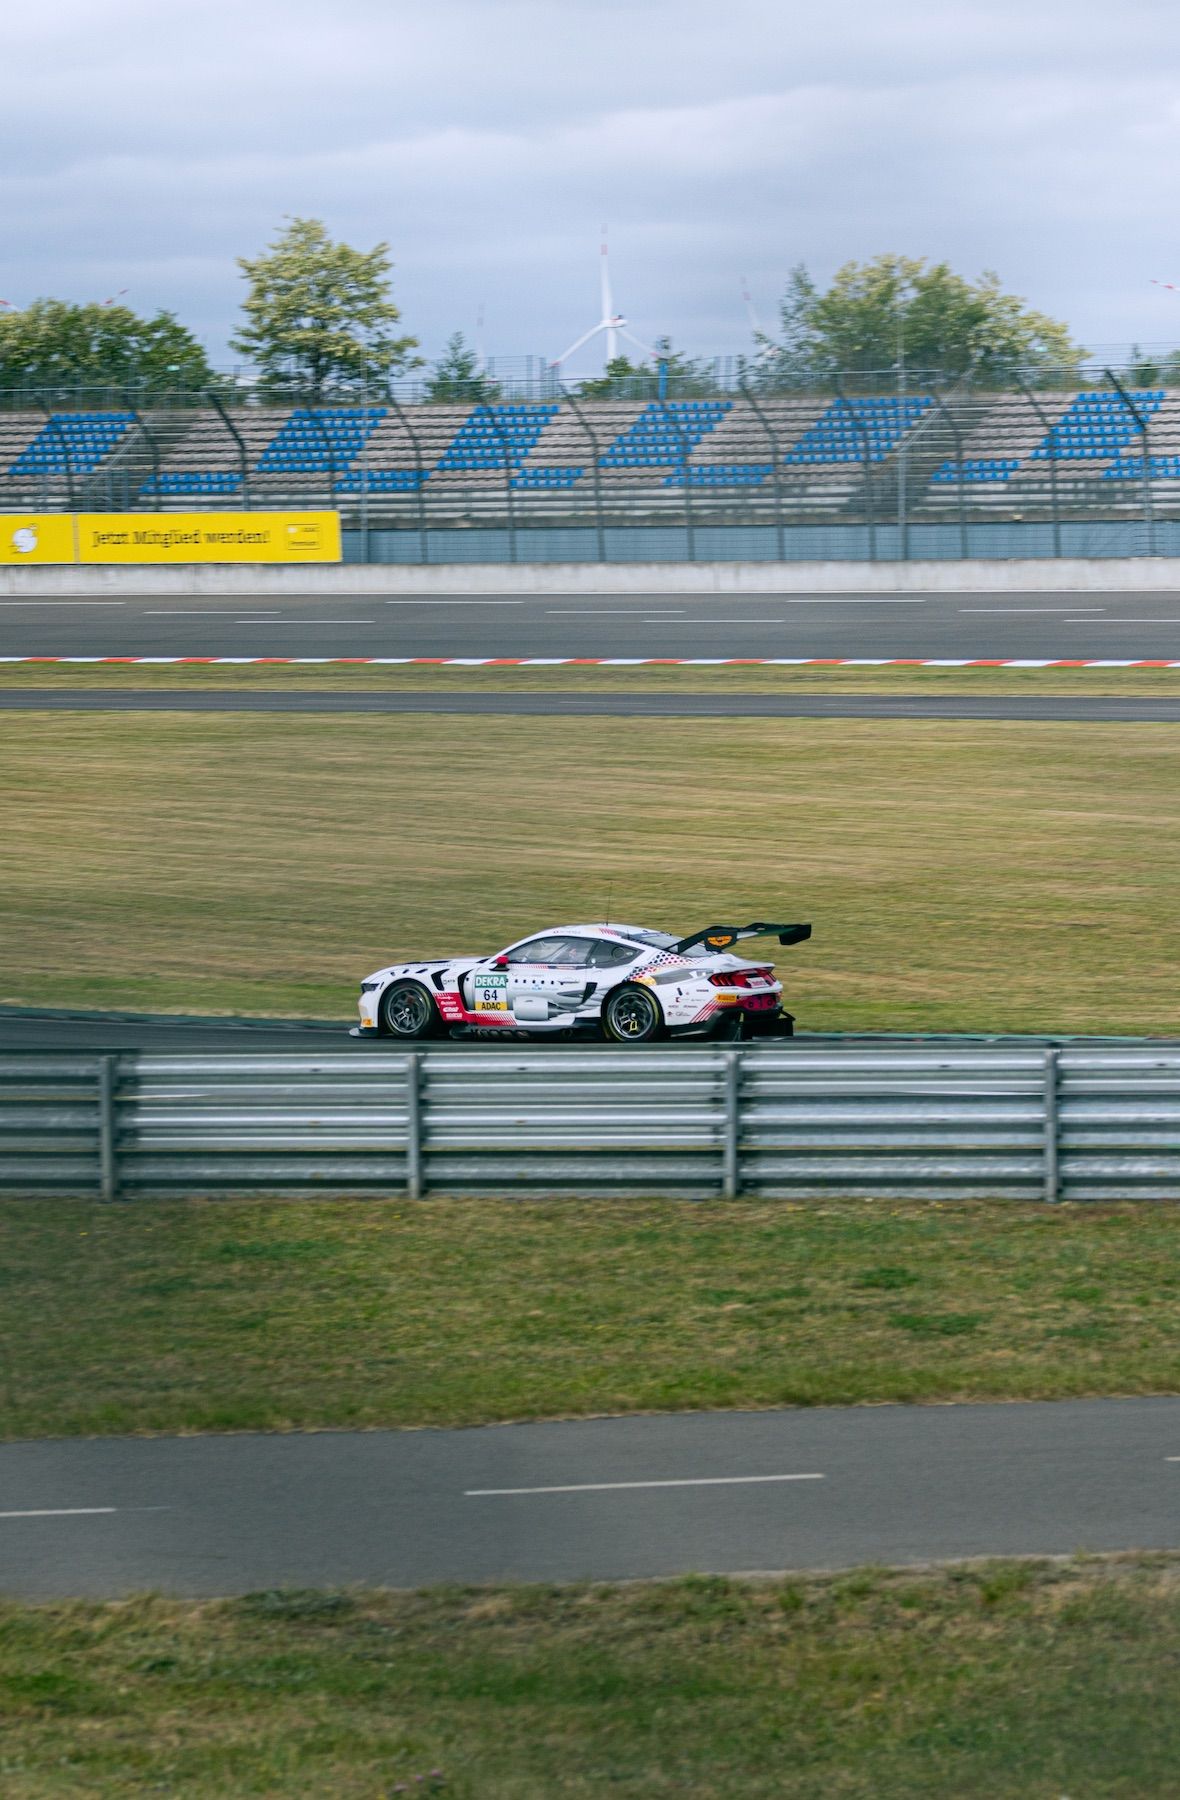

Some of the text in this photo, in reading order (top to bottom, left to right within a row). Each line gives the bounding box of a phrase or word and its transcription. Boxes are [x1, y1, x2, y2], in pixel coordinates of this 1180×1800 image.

[92, 529, 271, 549] Jetzt Mitglied werden!
[475, 975, 507, 987] DEKRA
[483, 989, 498, 1001] 64
[481, 1002, 502, 1011] ADAC
